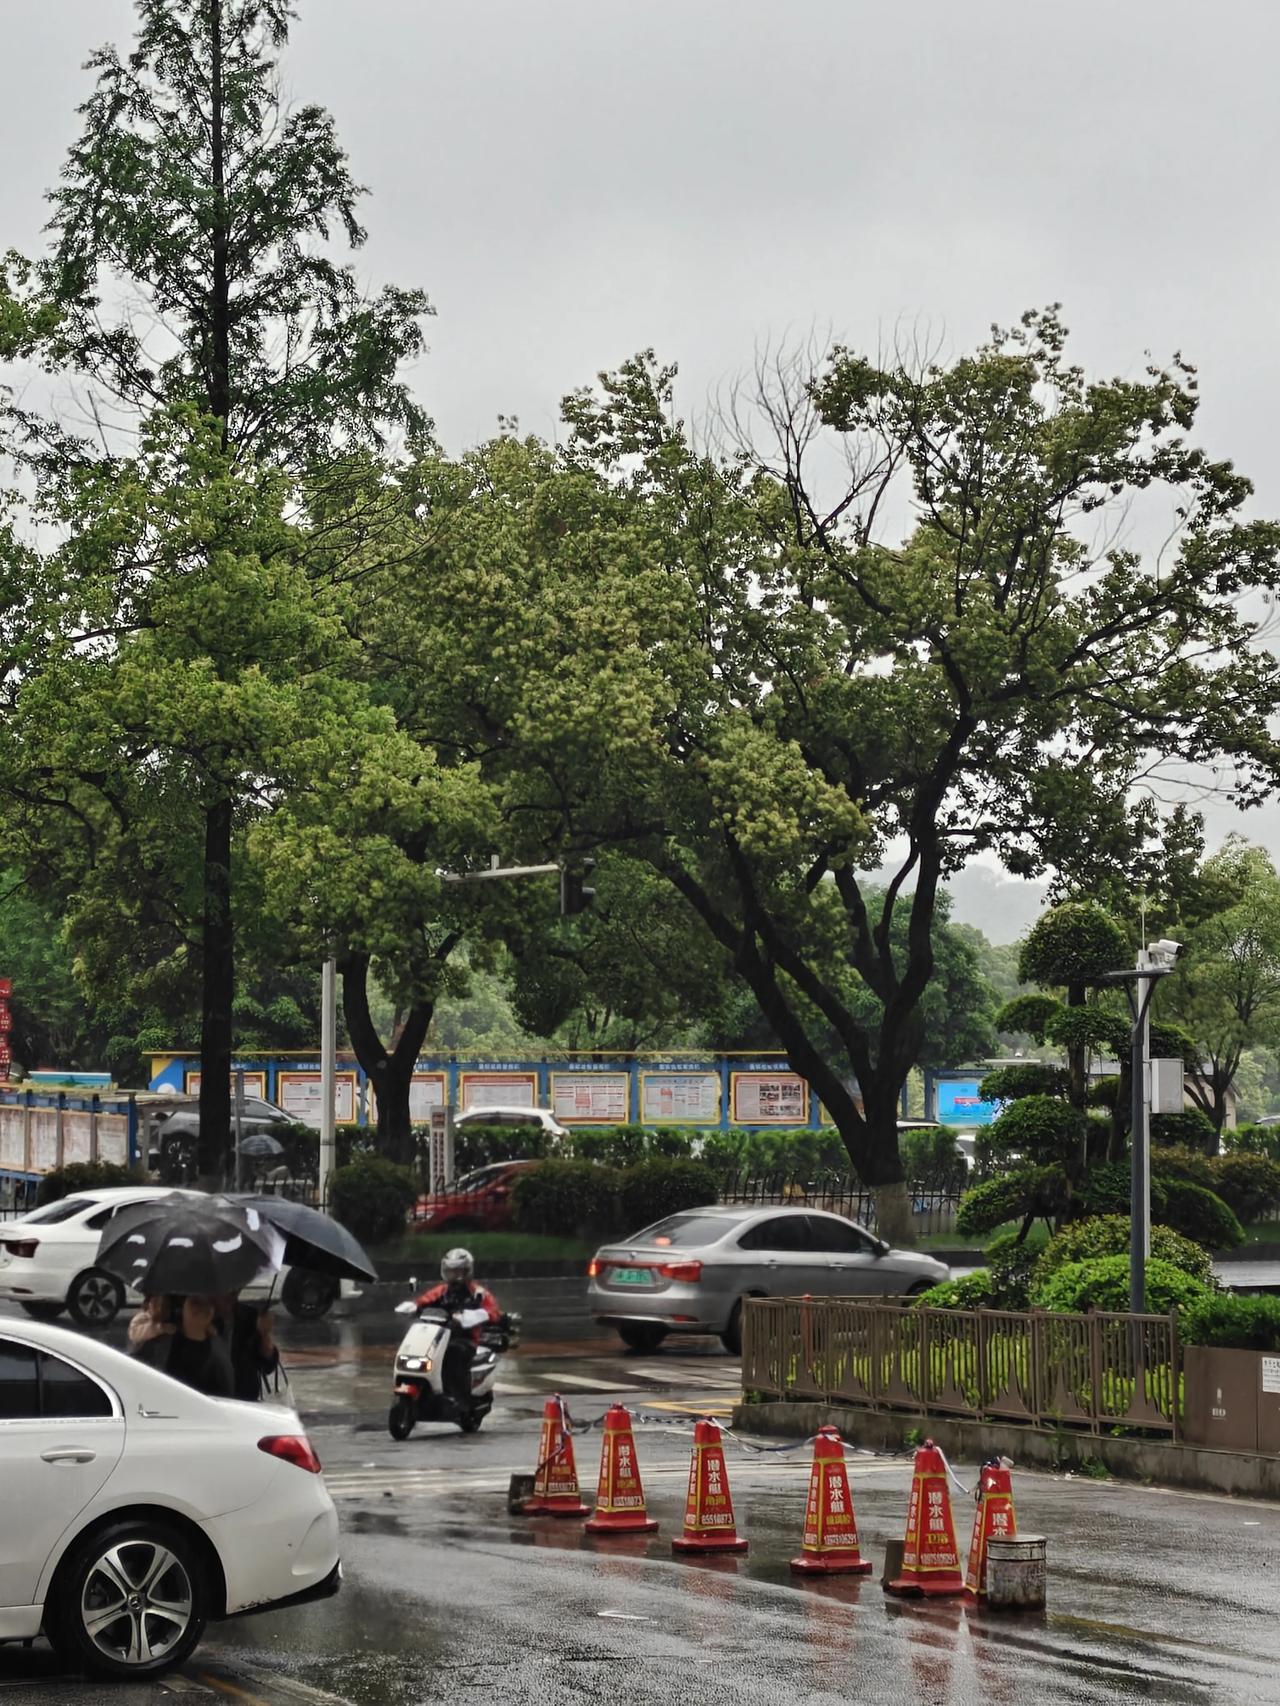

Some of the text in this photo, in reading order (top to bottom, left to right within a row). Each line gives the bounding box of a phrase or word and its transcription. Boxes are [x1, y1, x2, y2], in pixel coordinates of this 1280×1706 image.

[829, 1476, 844, 1513] 潜水艇
[928, 1491, 945, 1531] 潜水艇
